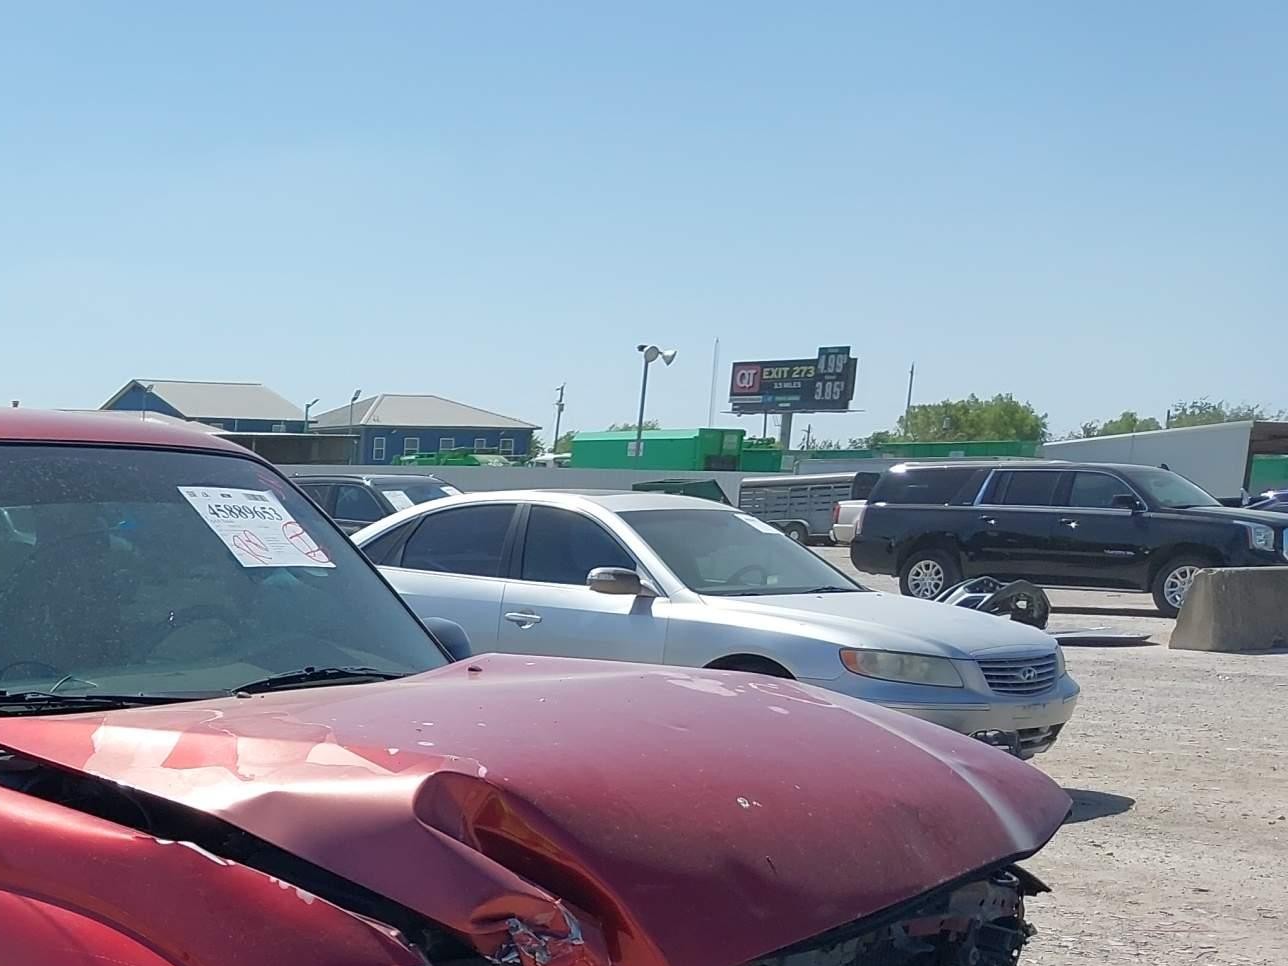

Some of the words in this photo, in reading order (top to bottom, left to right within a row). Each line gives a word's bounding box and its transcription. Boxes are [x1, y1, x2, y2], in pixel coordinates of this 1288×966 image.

[737, 370, 756, 387] QT
[763, 368, 789, 378] EXIT
[791, 366, 815, 378] 273
[207, 503, 283, 521] 45889653
